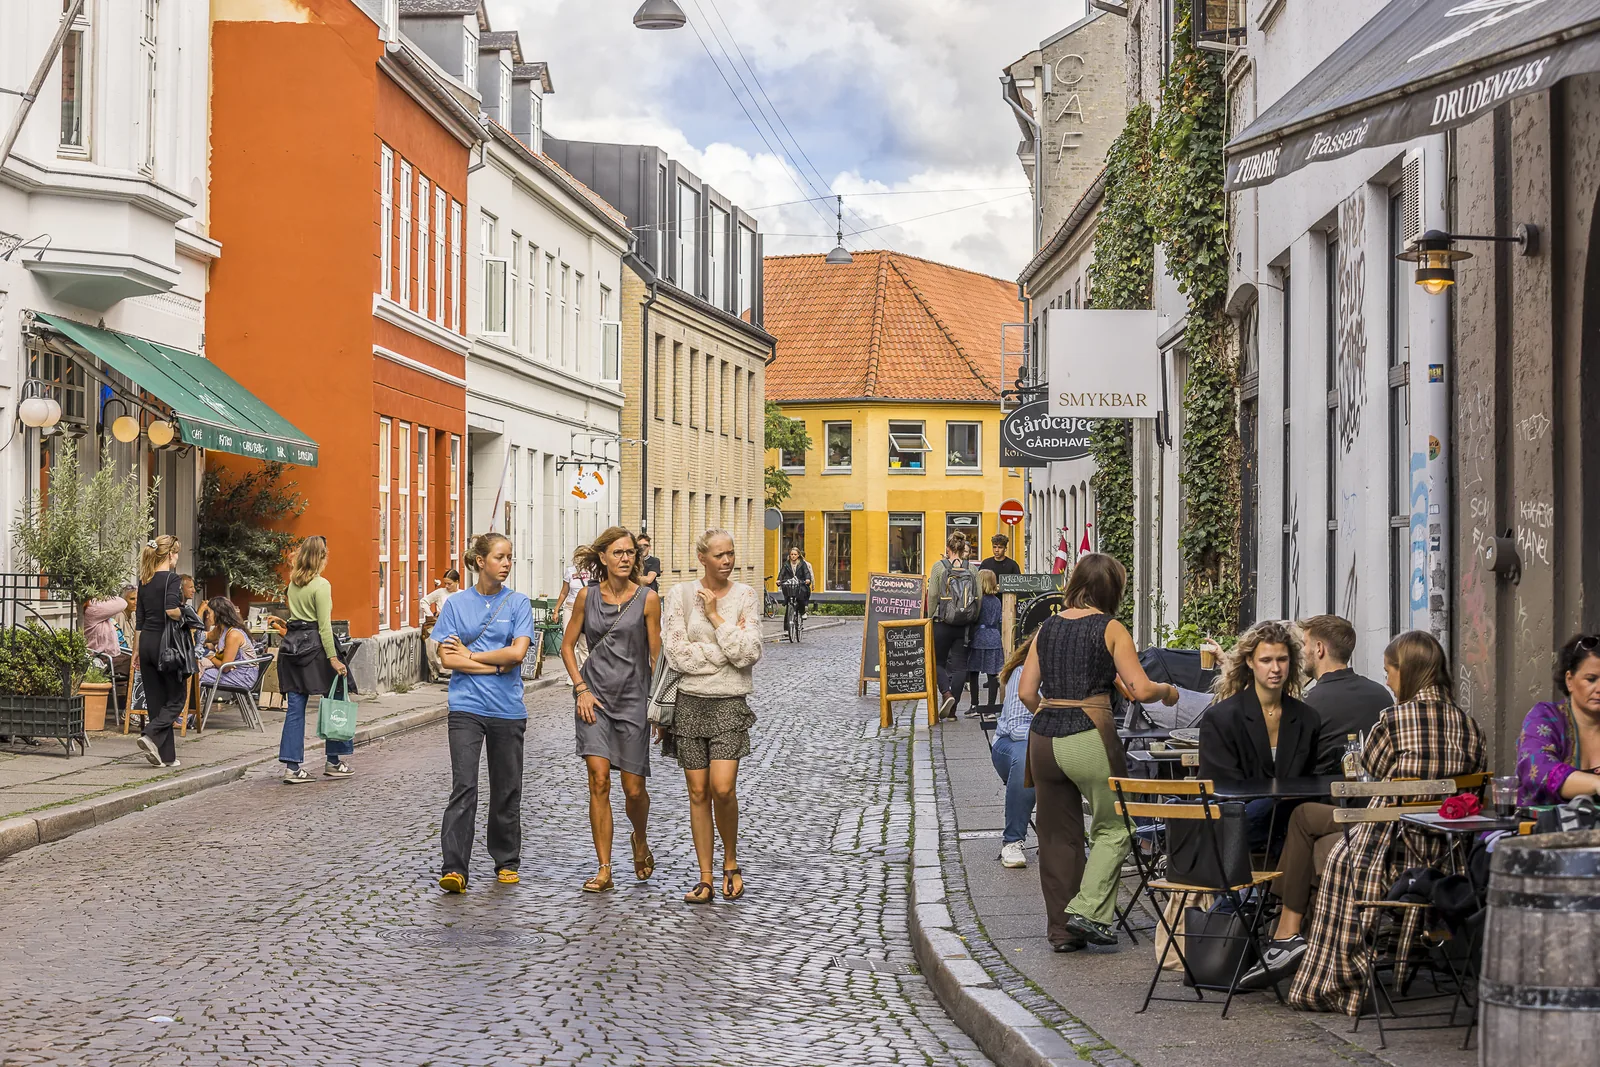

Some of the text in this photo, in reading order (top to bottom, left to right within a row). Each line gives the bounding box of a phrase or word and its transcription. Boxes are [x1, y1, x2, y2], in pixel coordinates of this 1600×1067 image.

[1431, 56, 1550, 126] DRUDENFUSS
[1233, 147, 1282, 184] TUBORG
[1059, 392, 1148, 407] SMYKBAR
[873, 579, 915, 589] SECONDHAND
[871, 596, 922, 609] FIND FESTIVALS
[875, 605, 912, 616] OUTFITTET
